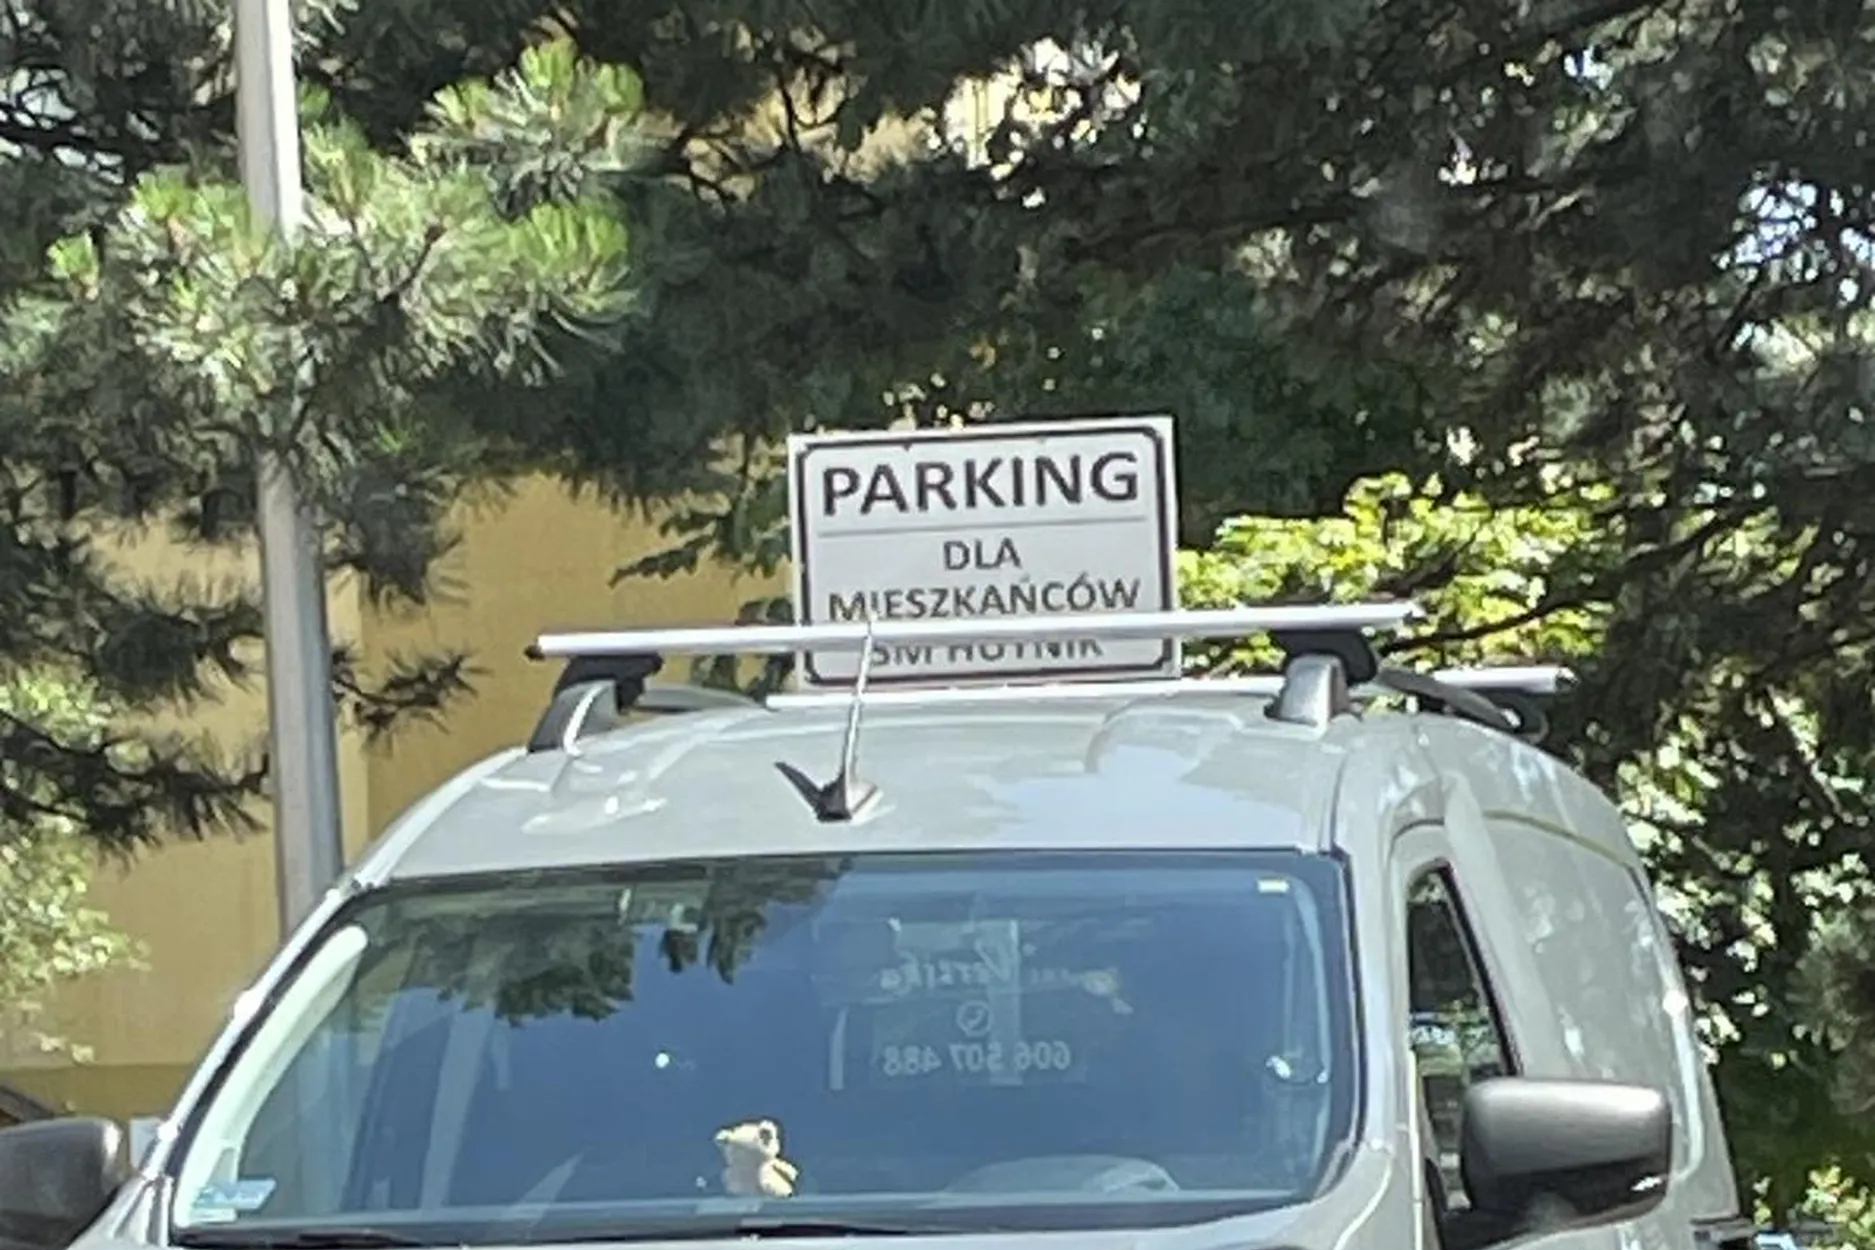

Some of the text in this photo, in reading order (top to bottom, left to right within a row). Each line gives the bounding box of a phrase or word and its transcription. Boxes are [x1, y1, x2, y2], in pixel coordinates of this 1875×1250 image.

[822, 451, 1138, 516] PARKING
[943, 536, 1022, 571] DLA
[828, 572, 1141, 622] MIESZKAŃCÓW
